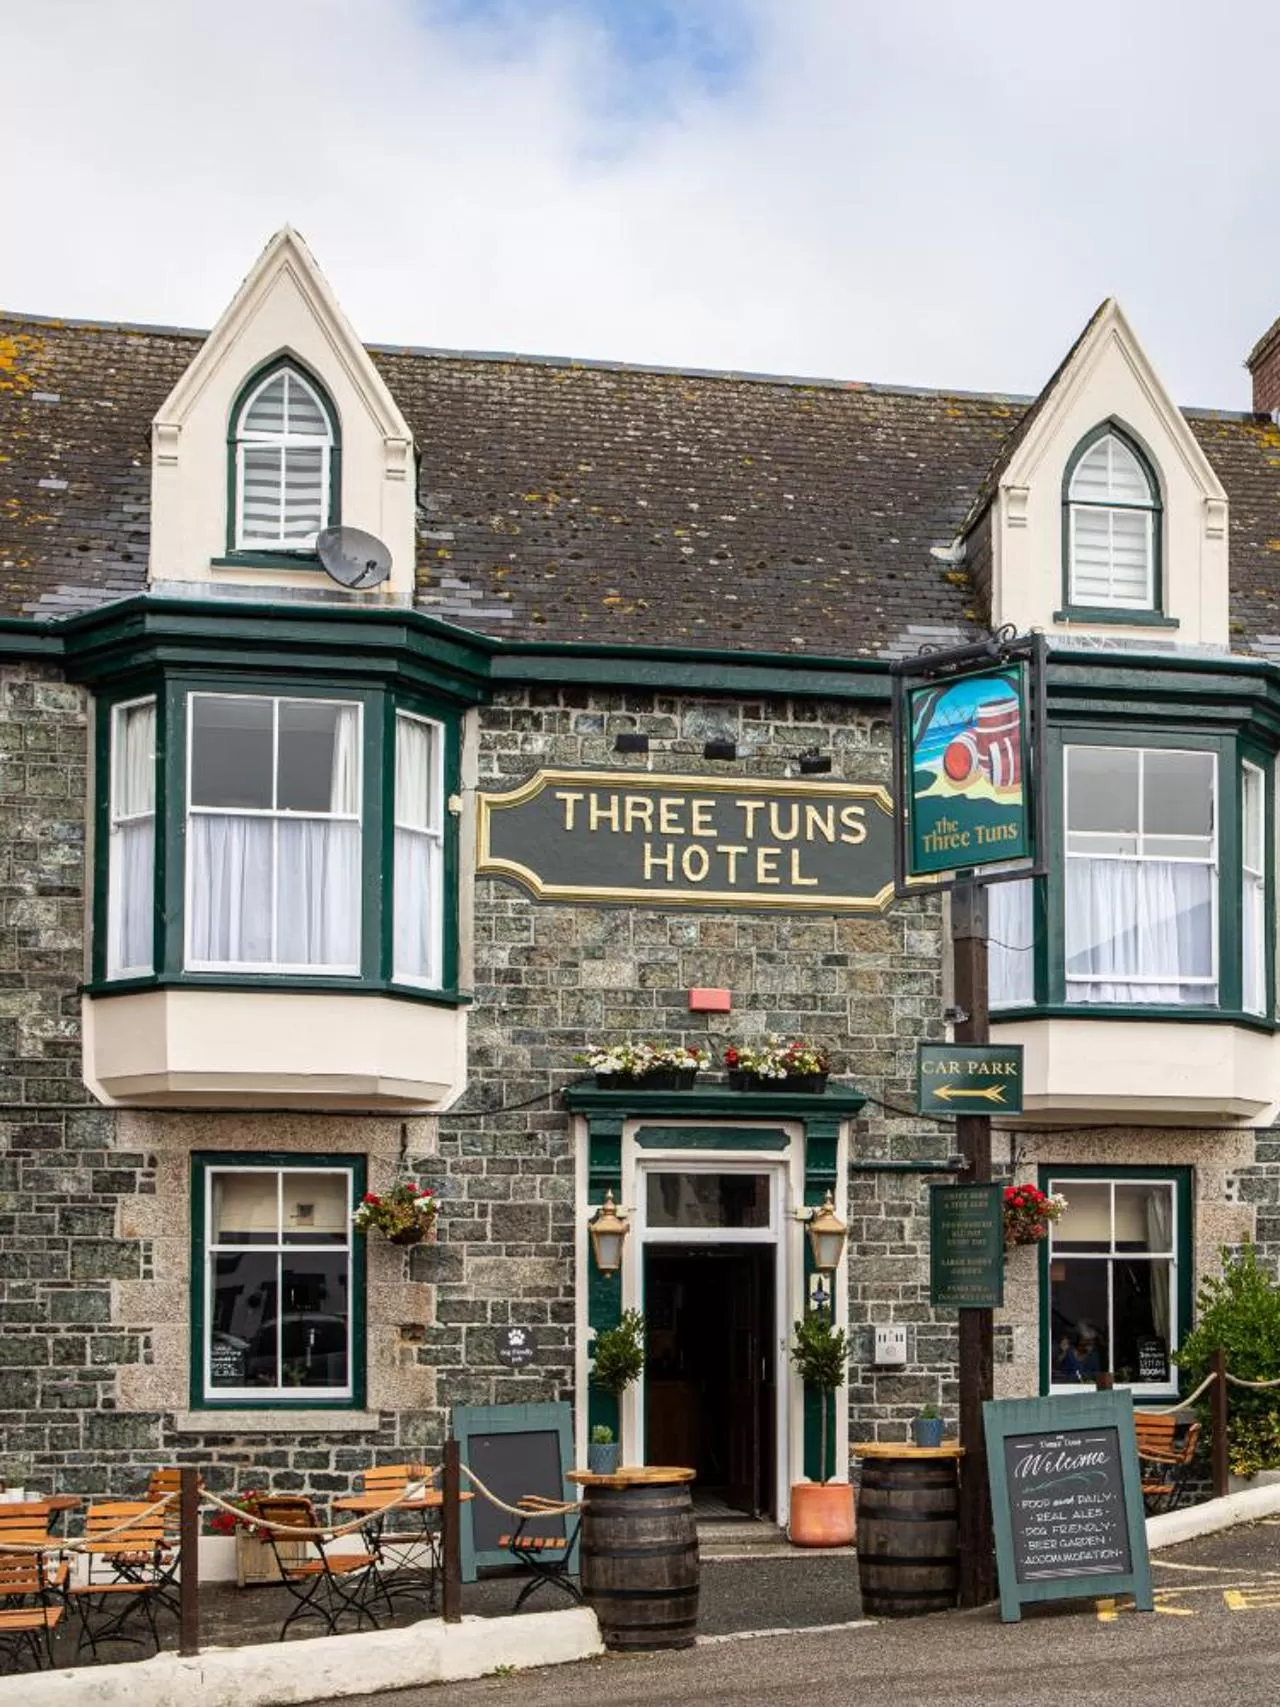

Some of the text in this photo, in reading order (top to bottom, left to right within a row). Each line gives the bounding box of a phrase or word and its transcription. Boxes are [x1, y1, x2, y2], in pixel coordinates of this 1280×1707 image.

[554, 791, 868, 845] THREE TUNS
[922, 822, 1018, 853] Three Tuns
[643, 842, 818, 886] HOTEL
[921, 1060, 1018, 1076] CAR PARK
[1014, 1451, 1110, 1478] Welcome
[1076, 1492, 1112, 1505] DAILY
[1035, 1508, 1104, 1522] REAL ALES
[1028, 1539, 1057, 1551] BEER
